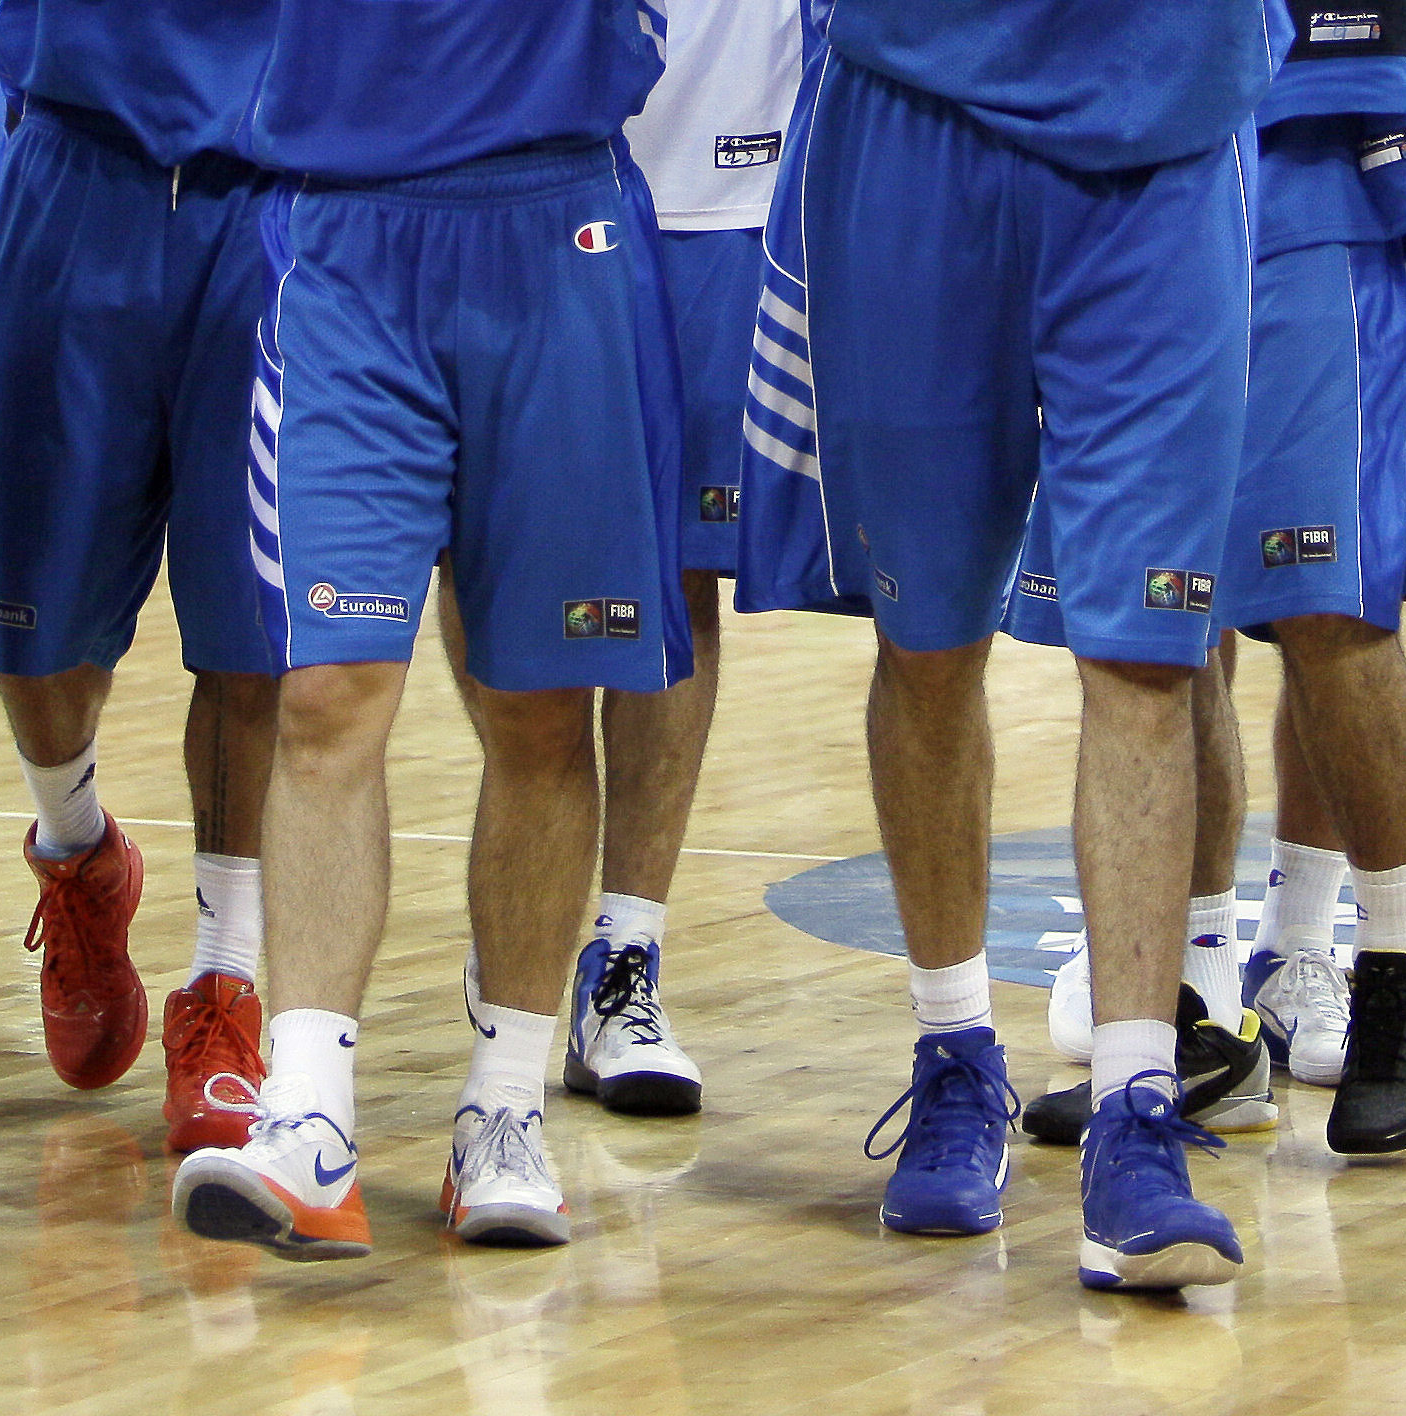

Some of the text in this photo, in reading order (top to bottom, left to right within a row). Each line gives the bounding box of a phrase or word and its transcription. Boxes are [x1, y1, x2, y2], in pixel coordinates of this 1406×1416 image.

[1302, 530, 1330, 544] FIBA
[1191, 577, 1212, 593] FIBA
[339, 598, 406, 617] Eurobank
[610, 603, 635, 619] FIBA
